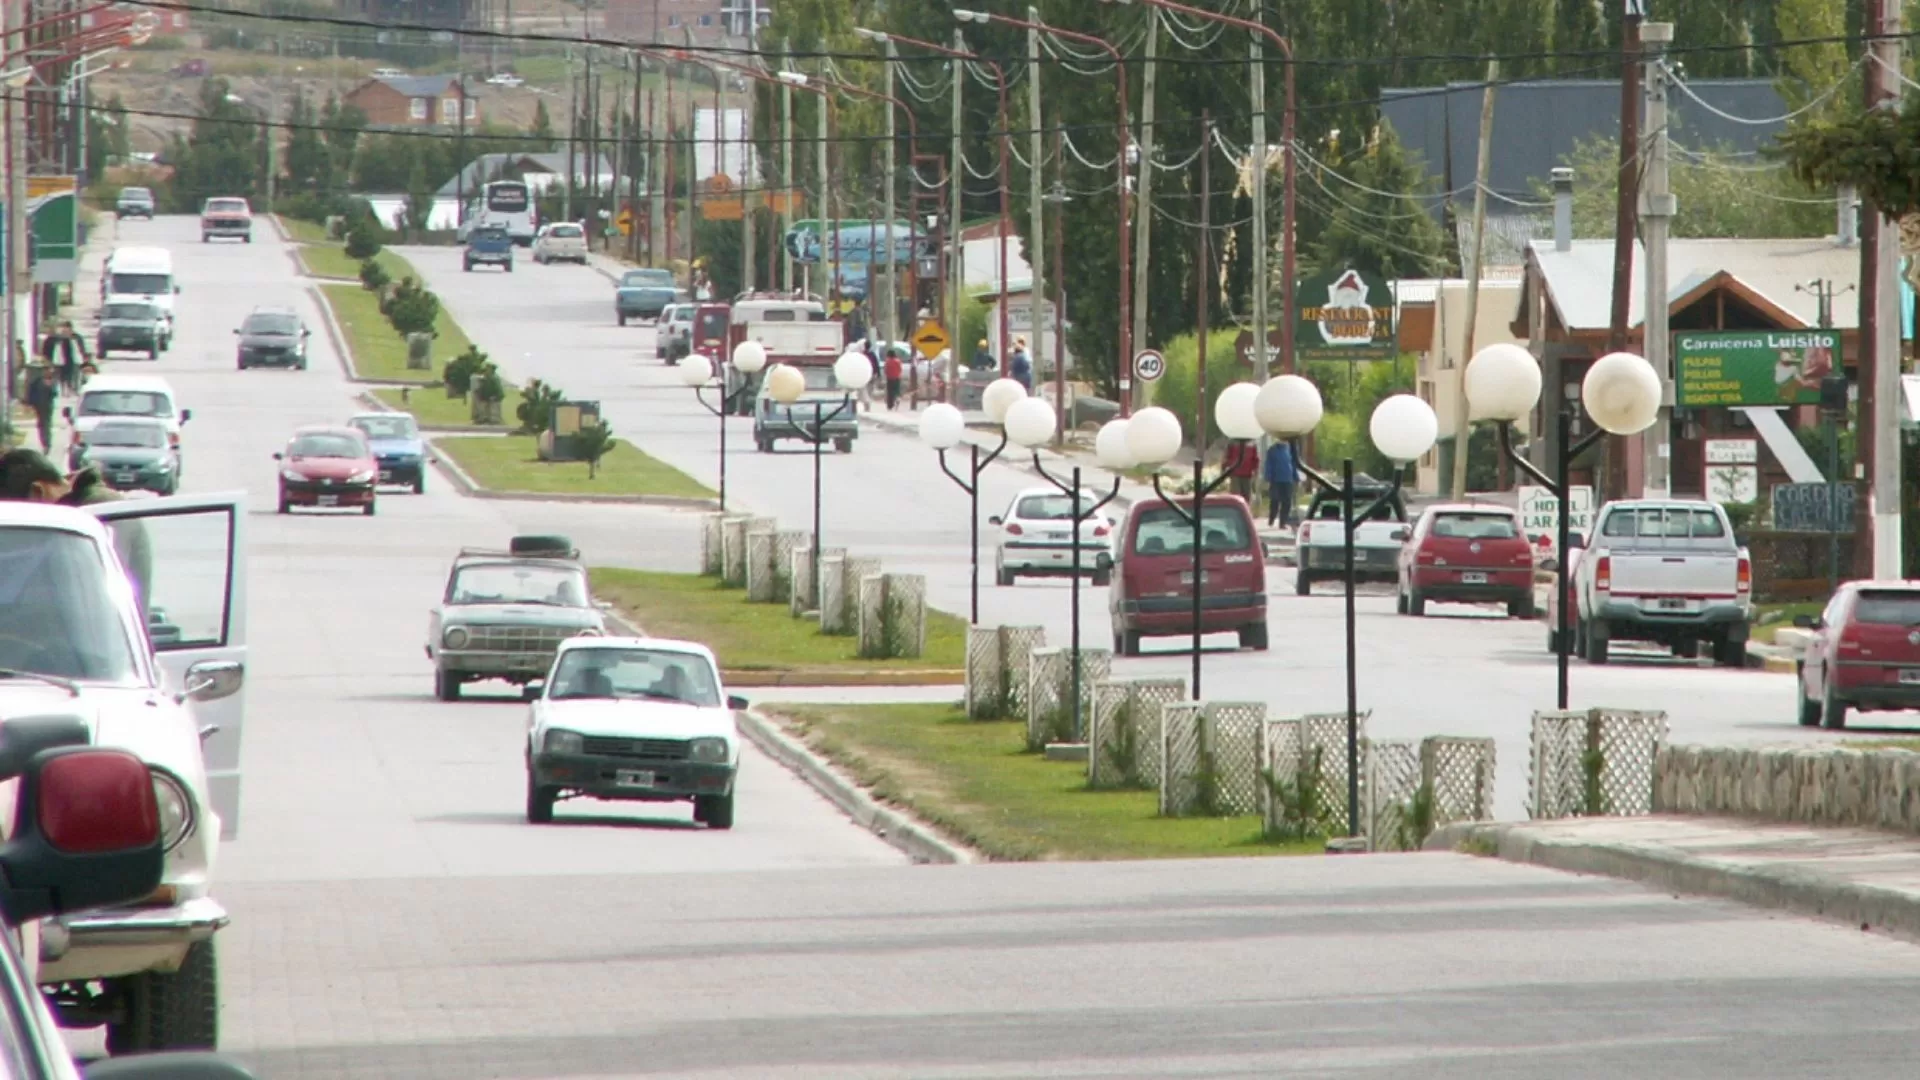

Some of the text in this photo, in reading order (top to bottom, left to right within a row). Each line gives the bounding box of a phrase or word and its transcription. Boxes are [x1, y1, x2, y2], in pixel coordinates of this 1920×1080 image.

[1767, 334, 1834, 348] Luisito
[1140, 360, 1159, 372] 40
[1534, 500, 1578, 512] HOL
[1523, 515, 1552, 528] LAR
